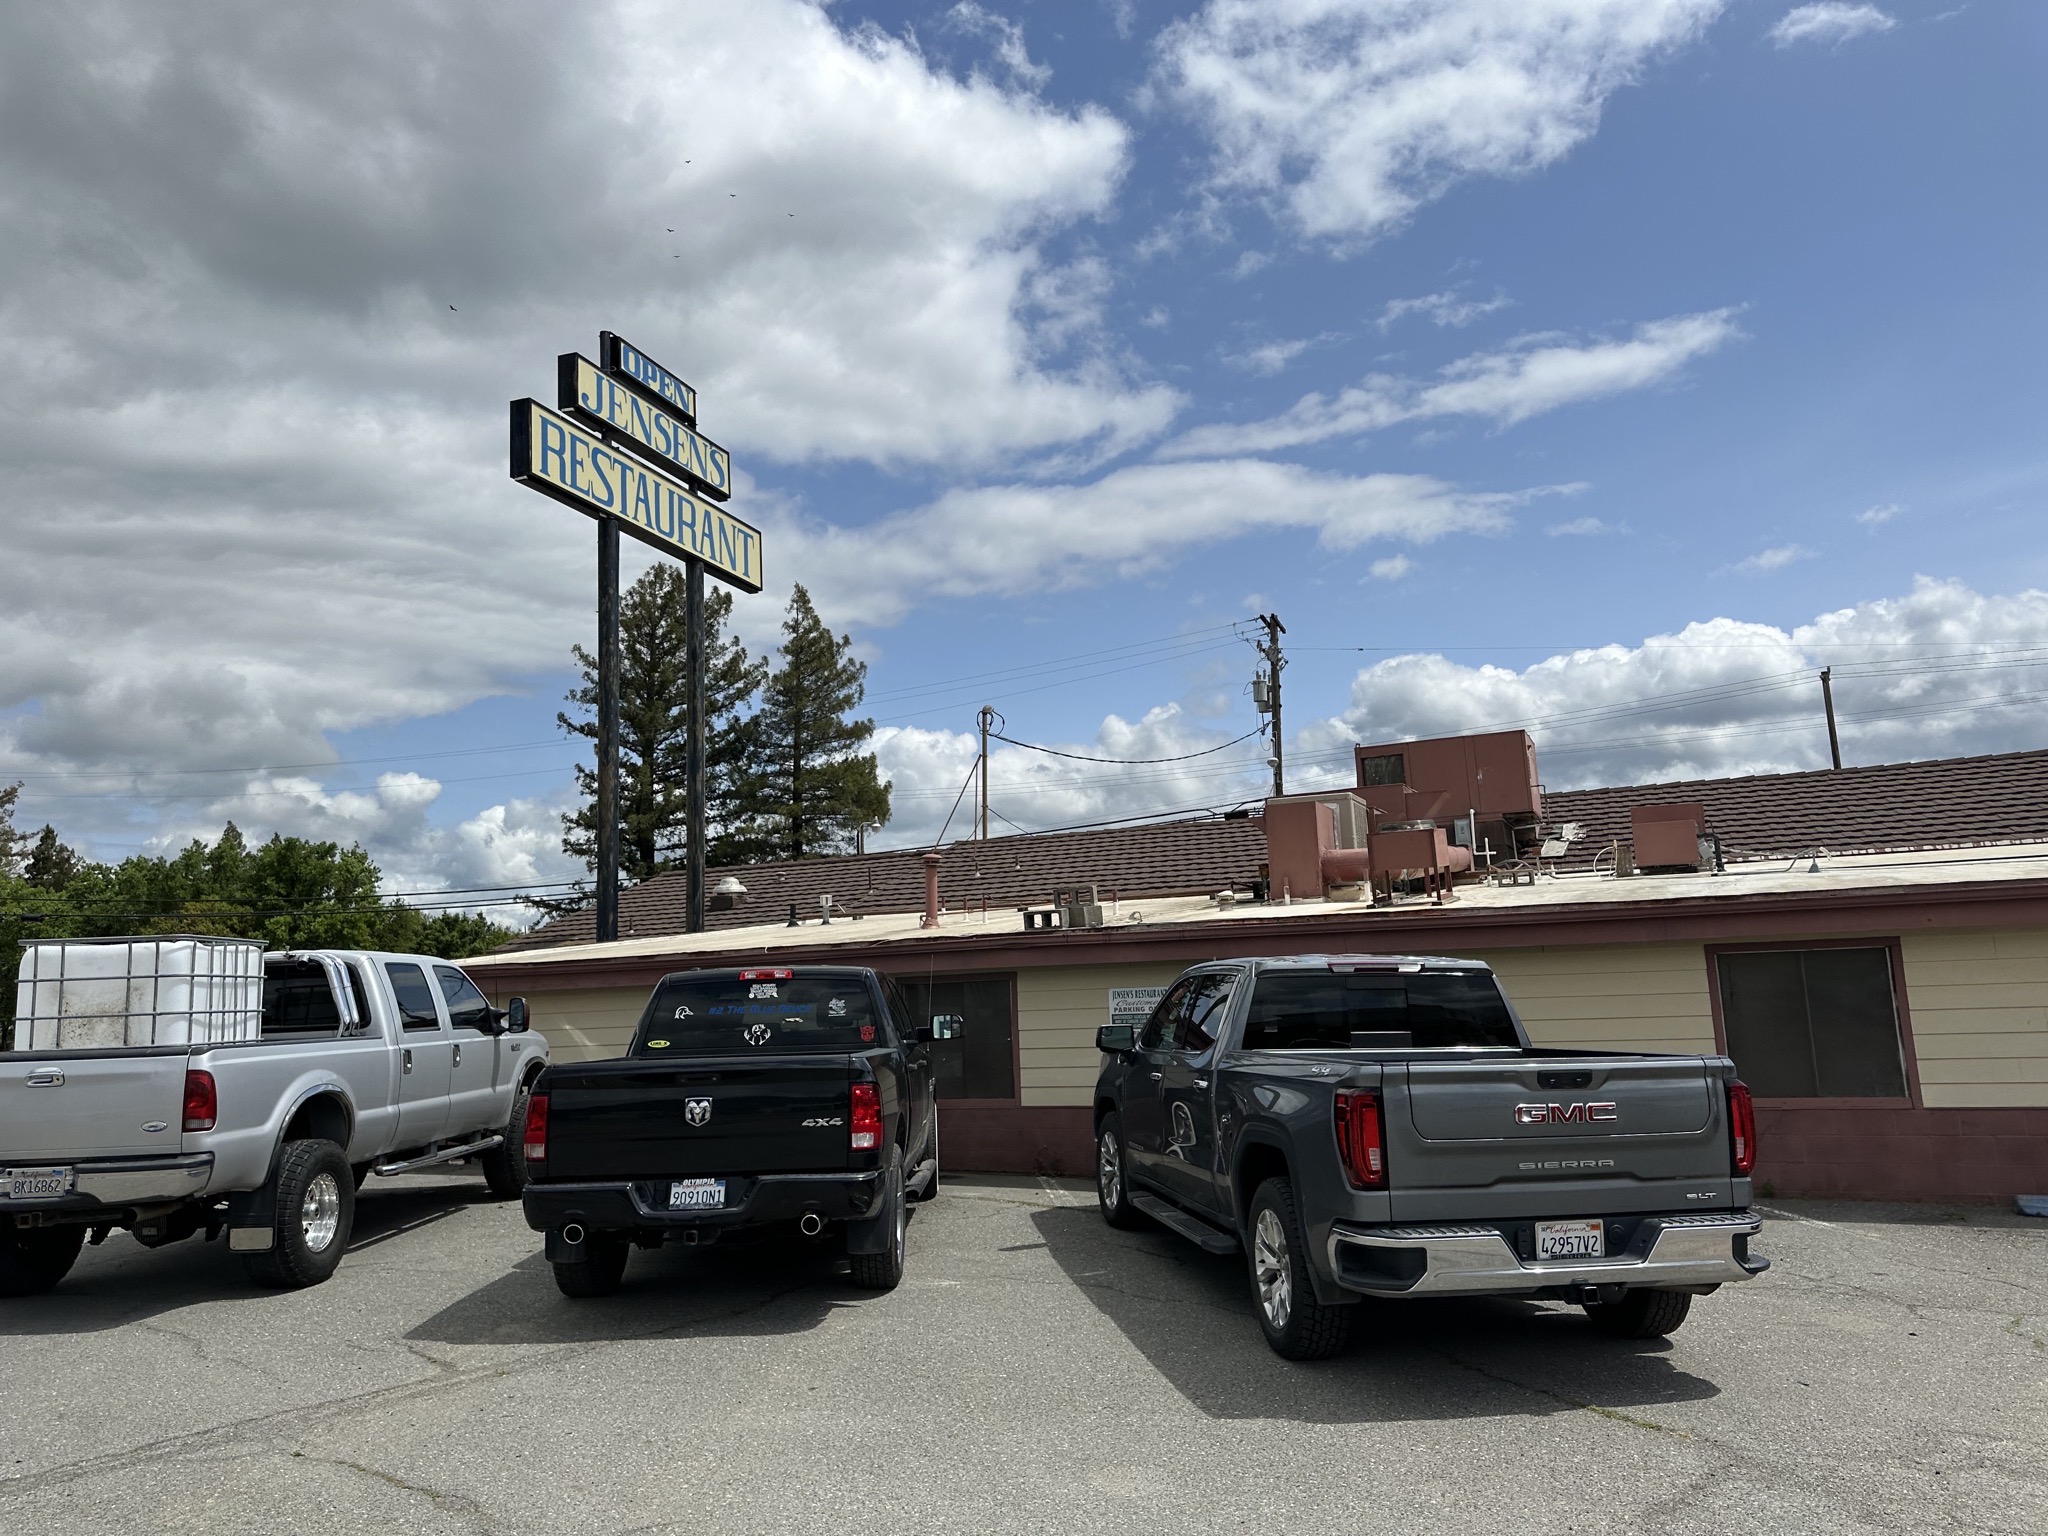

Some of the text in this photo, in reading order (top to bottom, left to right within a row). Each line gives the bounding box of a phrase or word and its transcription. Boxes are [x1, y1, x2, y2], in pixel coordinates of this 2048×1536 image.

[622, 343, 692, 415] OPEN
[538, 414, 755, 579] RESTAURANT
[1112, 990, 1134, 1001] JENSEN'S
[1515, 1102, 1618, 1125] GMC
[1518, 1159, 1615, 1170] SIERRA
[13, 1179, 61, 1194] 8K16862
[682, 1178, 716, 1186] OLYMPIA
[1686, 1192, 1717, 1200] SLT
[1541, 1235, 1599, 1255] 42957V2
